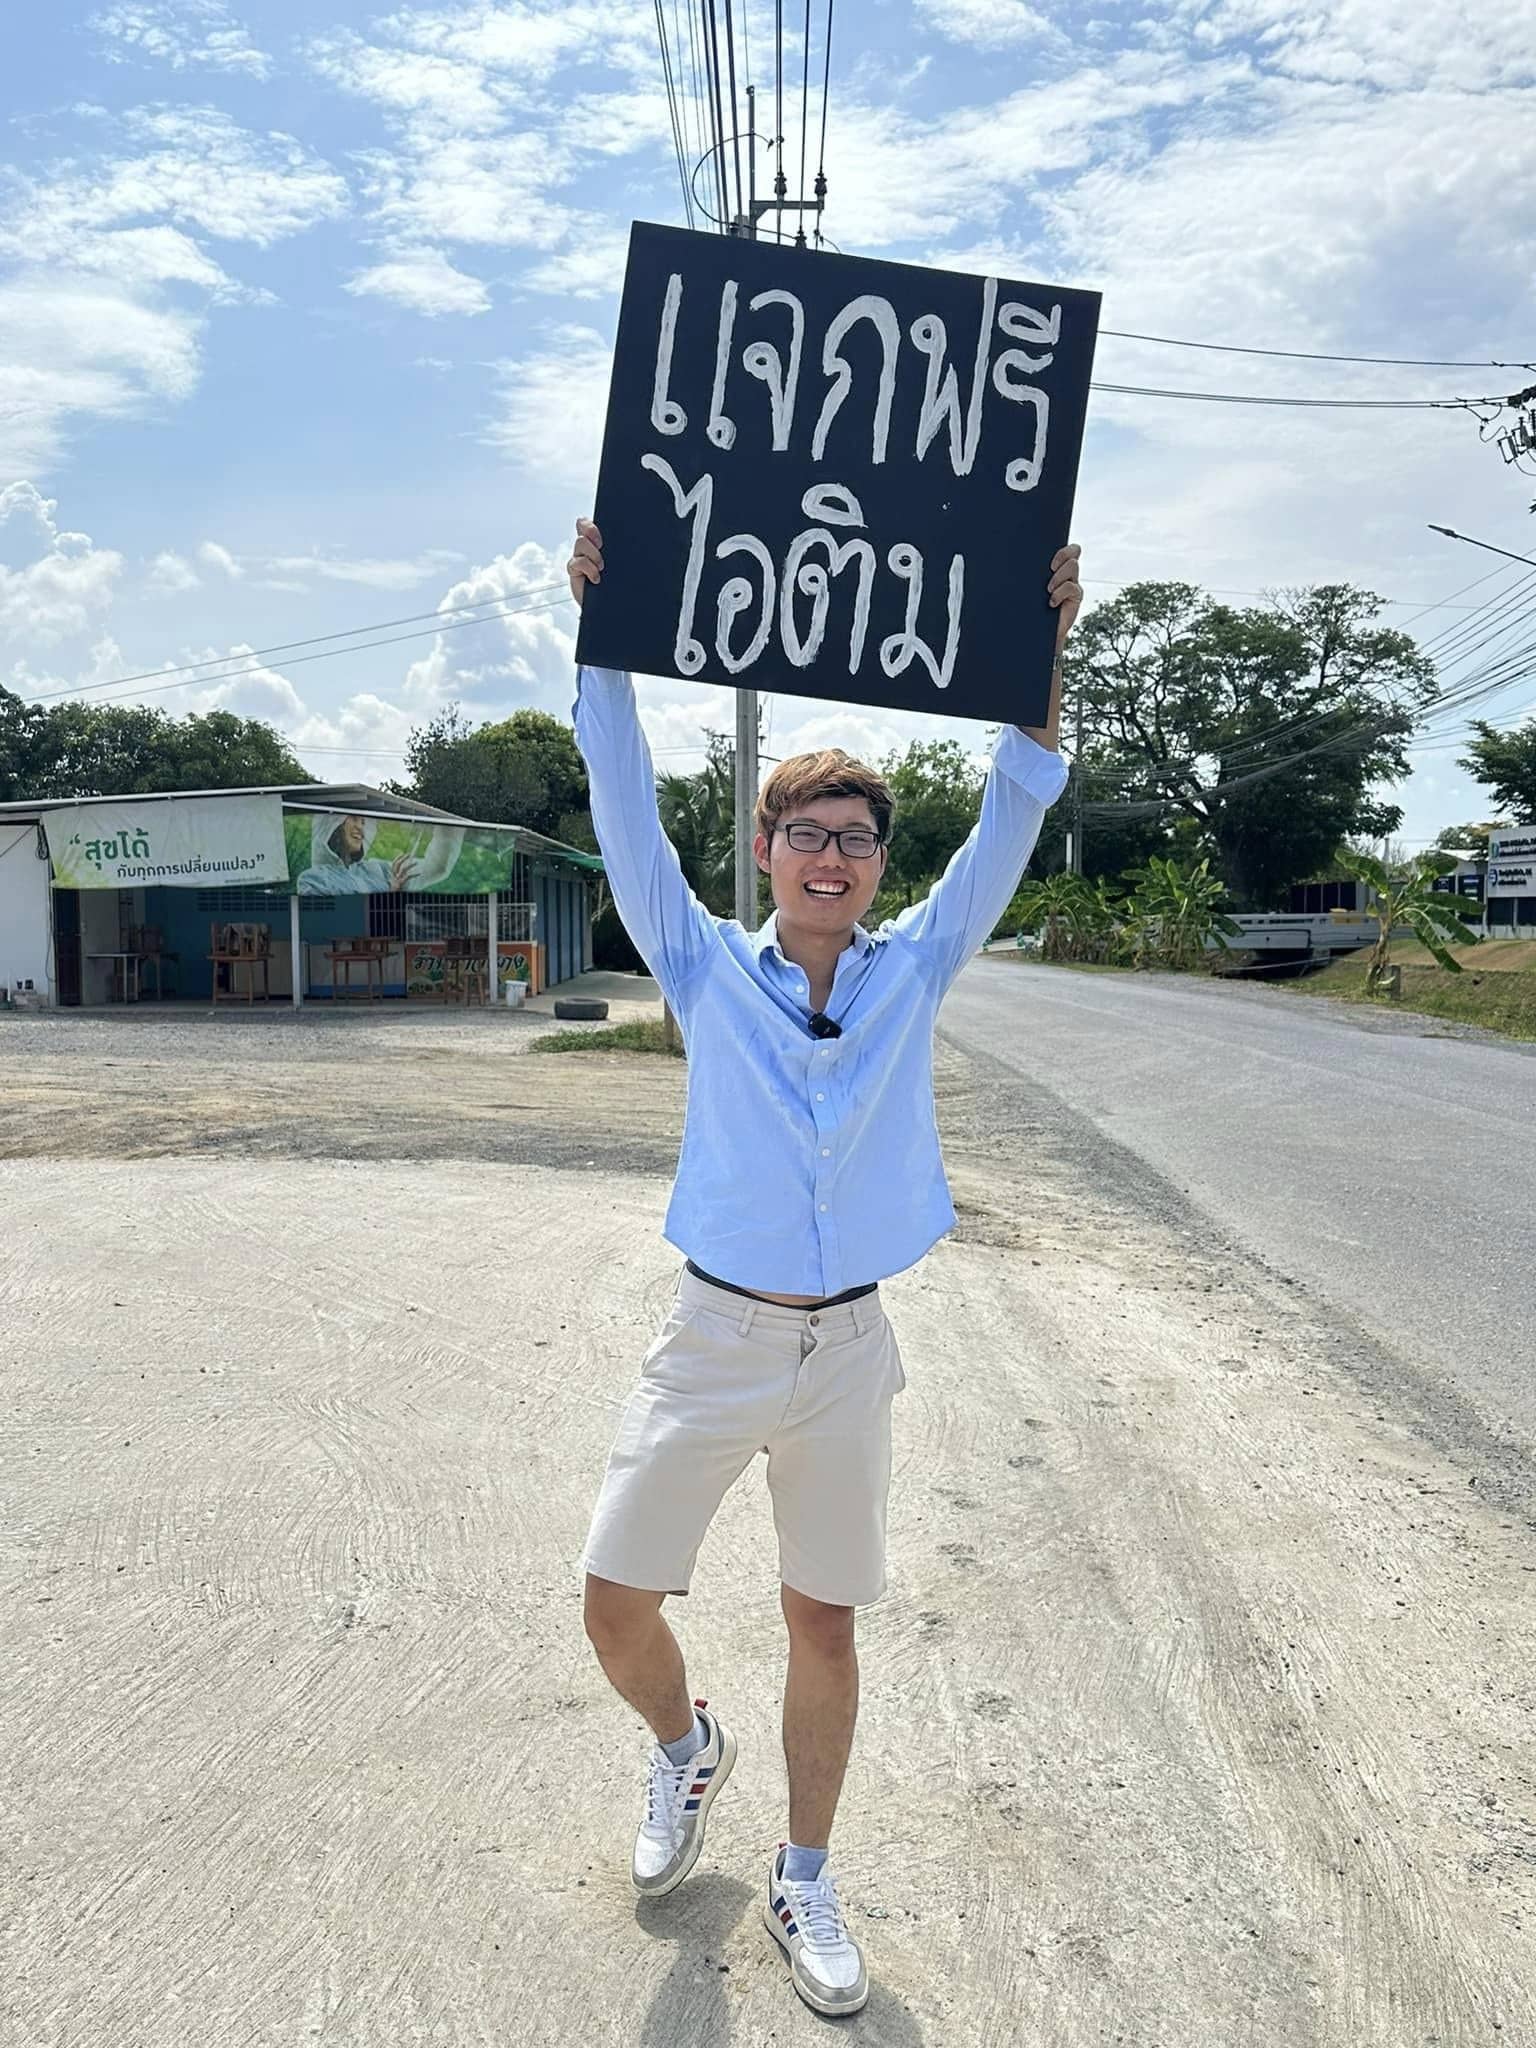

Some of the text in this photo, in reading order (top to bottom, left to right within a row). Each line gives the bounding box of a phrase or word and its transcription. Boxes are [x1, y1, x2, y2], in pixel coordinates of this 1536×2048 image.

[651, 274, 1061, 491] แจกฟรี
[641, 453, 964, 688] ไอติม
